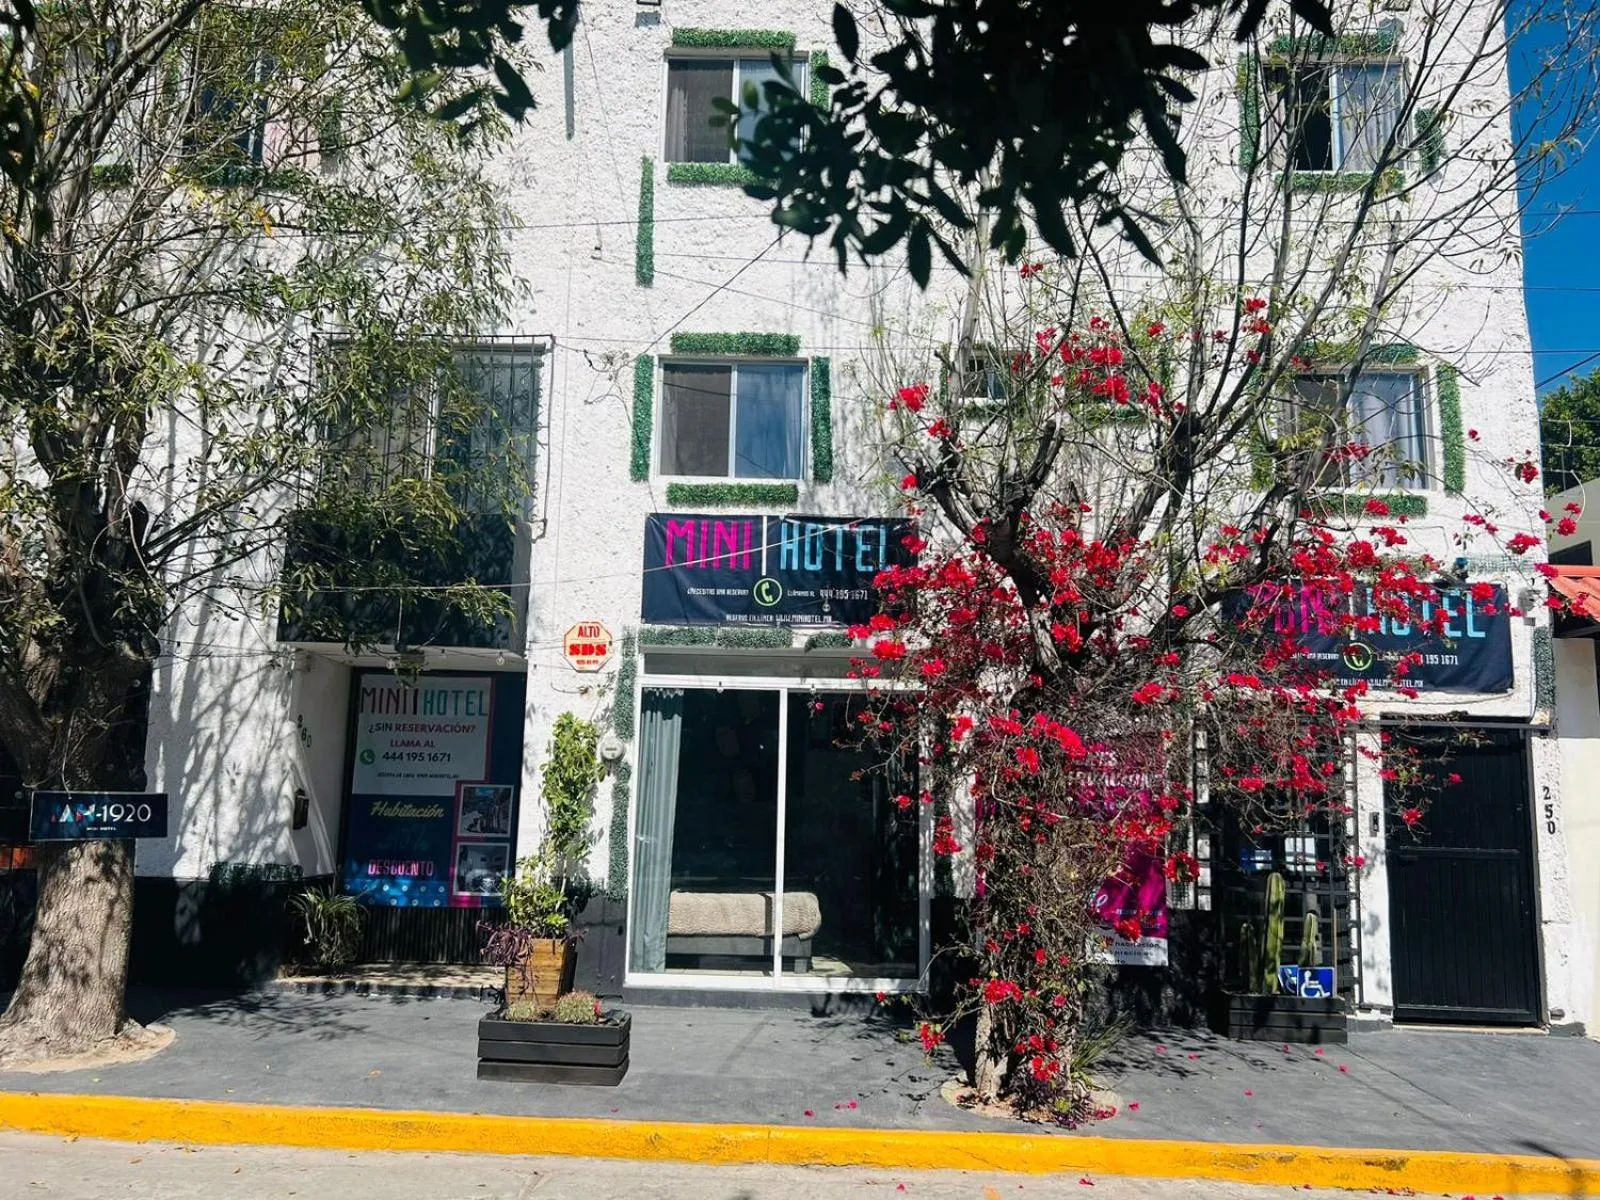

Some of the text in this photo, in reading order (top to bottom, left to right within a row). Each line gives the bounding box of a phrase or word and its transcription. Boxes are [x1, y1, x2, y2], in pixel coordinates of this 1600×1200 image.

[666, 520, 892, 571] MINI HOTEL
[578, 625, 600, 638] ALTO
[569, 643, 607, 656] SDS
[1425, 653, 1458, 665] 195 1671
[360, 687, 489, 717] MINI HOTEL
[368, 722, 477, 734] ¿SIN RESERVACIÓN?
[390, 739, 436, 749] LLAMA AL
[382, 752, 452, 762] 444 195 1671
[370, 802, 445, 818] Habitación
[1541, 785, 1556, 835] 250
[367, 859, 434, 877] DESCUENTO
